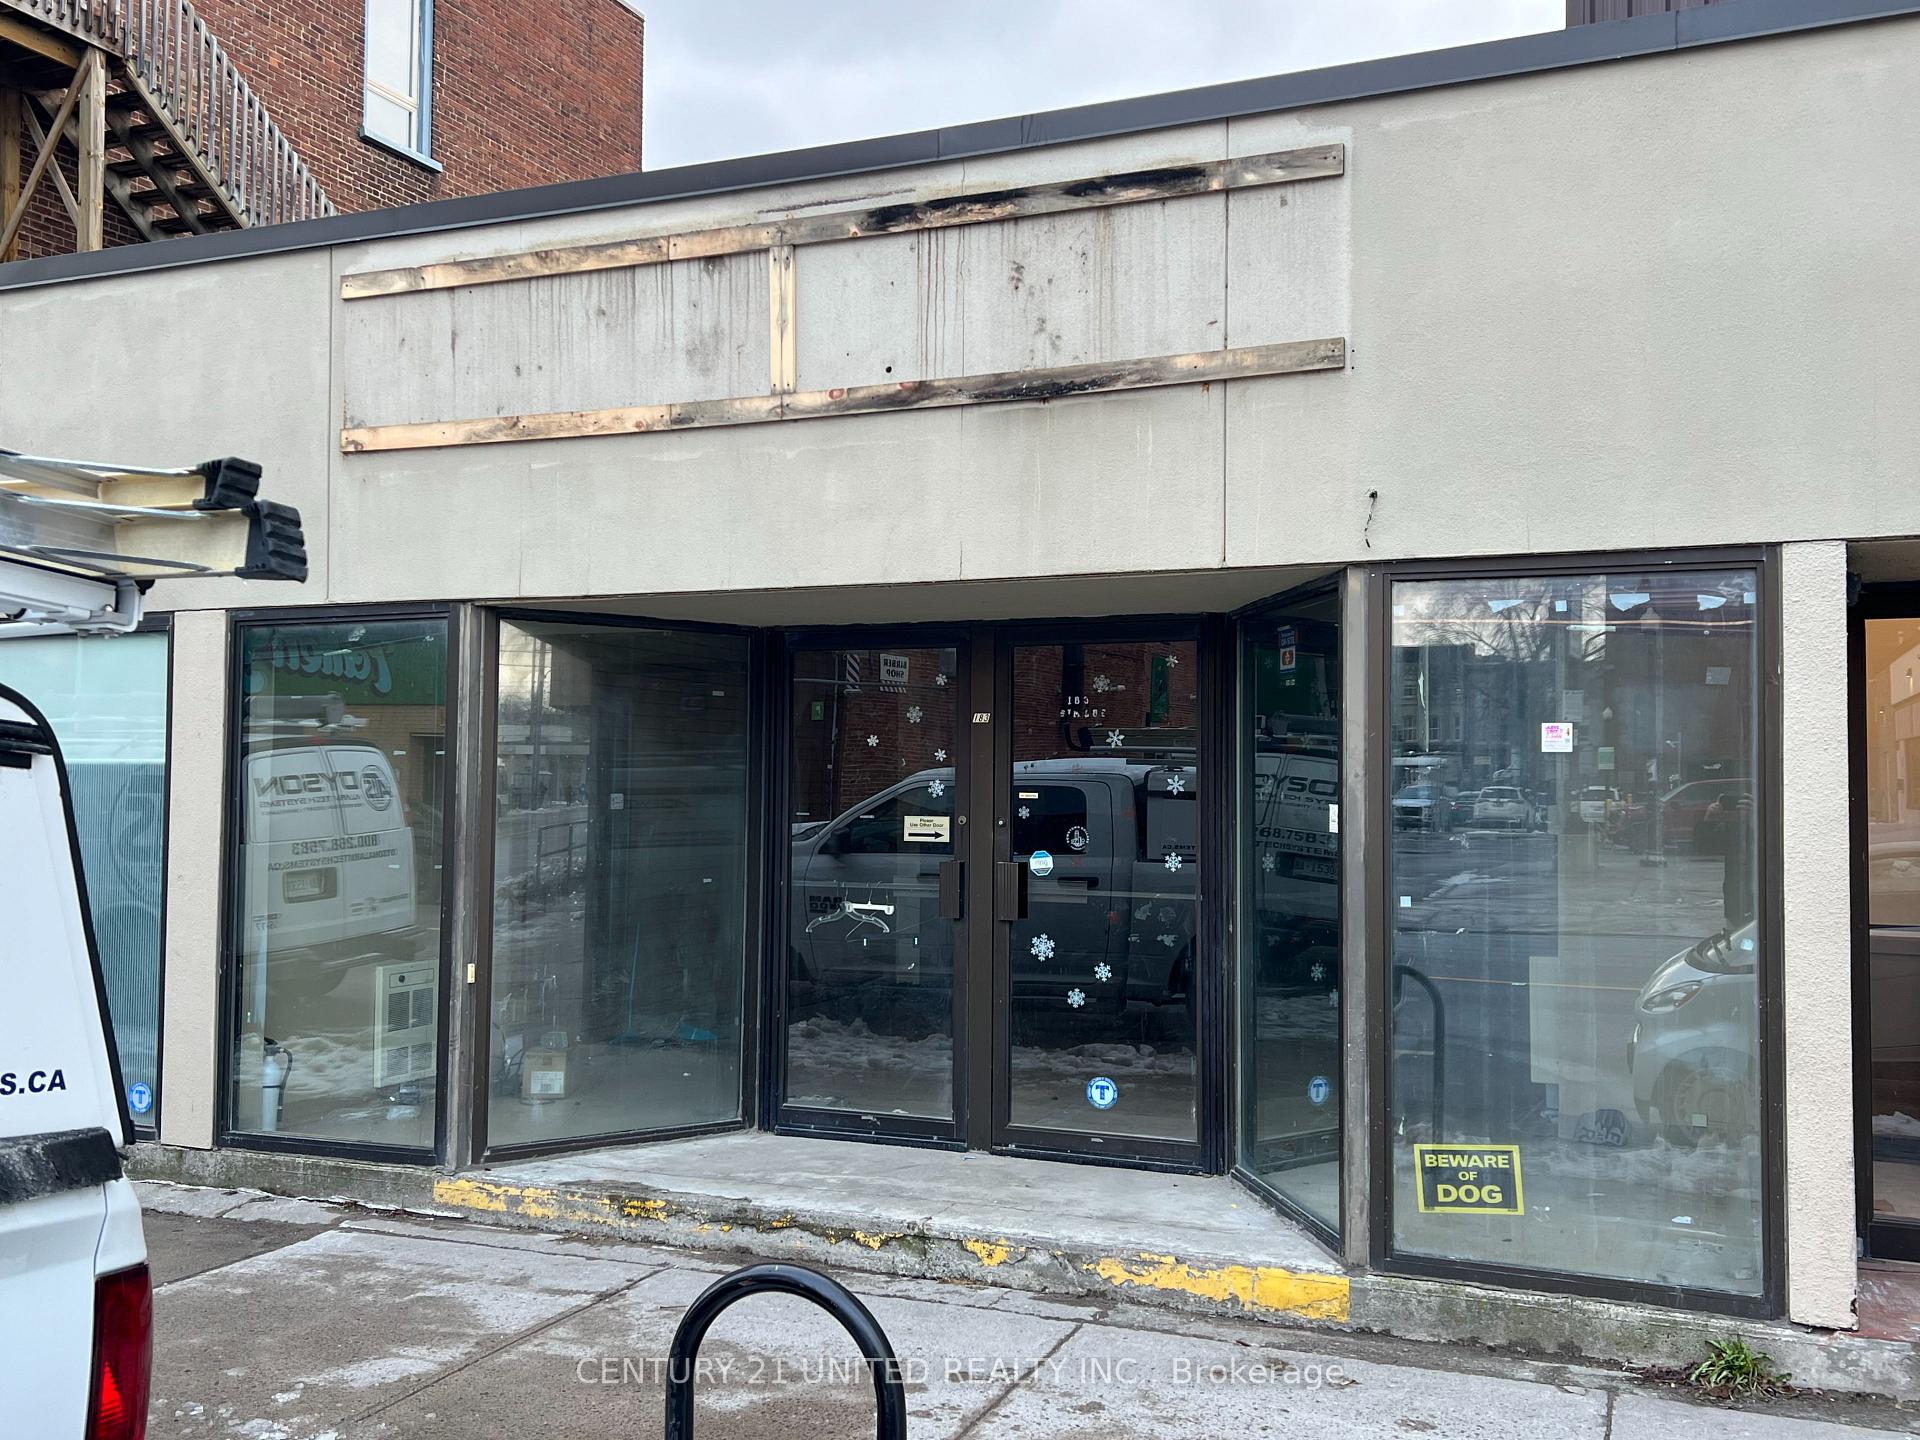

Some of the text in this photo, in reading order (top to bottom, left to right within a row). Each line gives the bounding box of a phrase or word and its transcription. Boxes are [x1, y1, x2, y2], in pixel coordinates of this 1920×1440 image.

[974, 713, 990, 722] 183
[1424, 1153, 1510, 1169] BEWARE
[1458, 1171, 1477, 1181] OF
[1437, 1183, 1503, 1205] DOG
